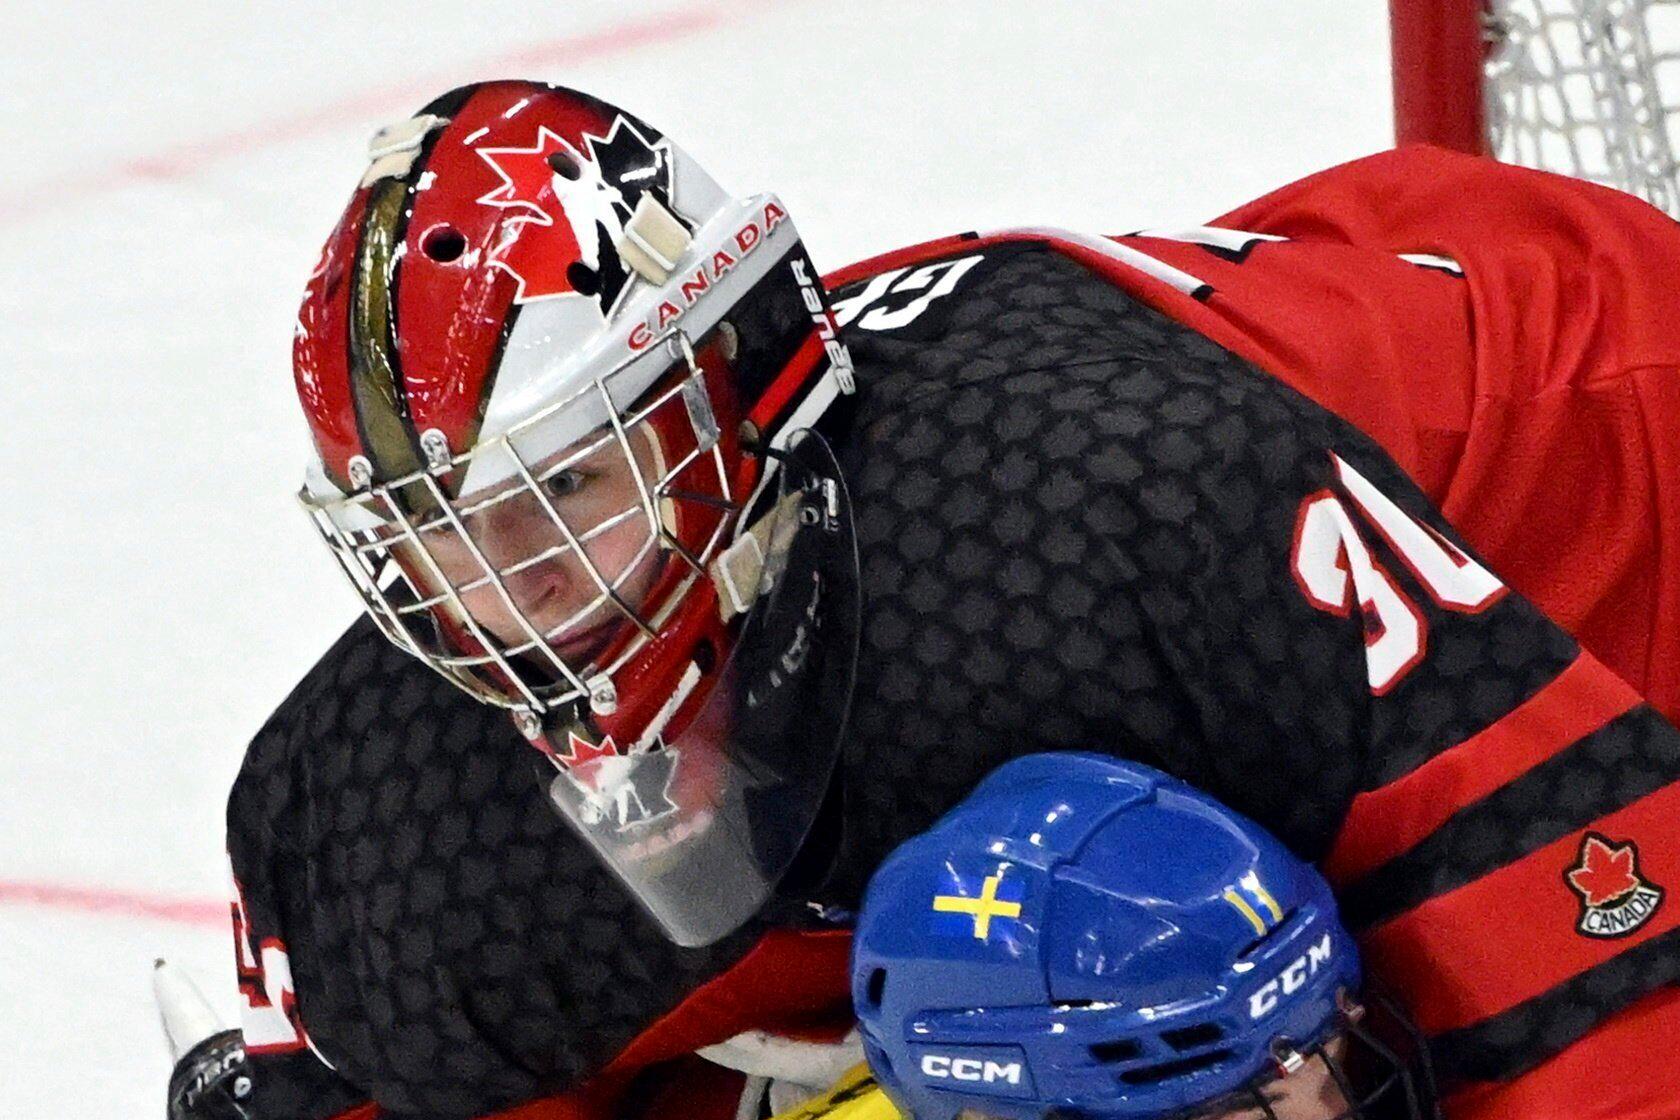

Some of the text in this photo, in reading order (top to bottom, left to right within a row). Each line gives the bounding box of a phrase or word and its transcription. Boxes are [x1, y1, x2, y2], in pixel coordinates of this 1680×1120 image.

[627, 202, 784, 351] CANADA
[1290, 448, 1511, 698] 30
[1222, 870, 1285, 938] 11
[1586, 890, 1660, 933] CANADA
[1248, 930, 1332, 1019] CCM
[920, 1054, 1022, 1085] CCM
